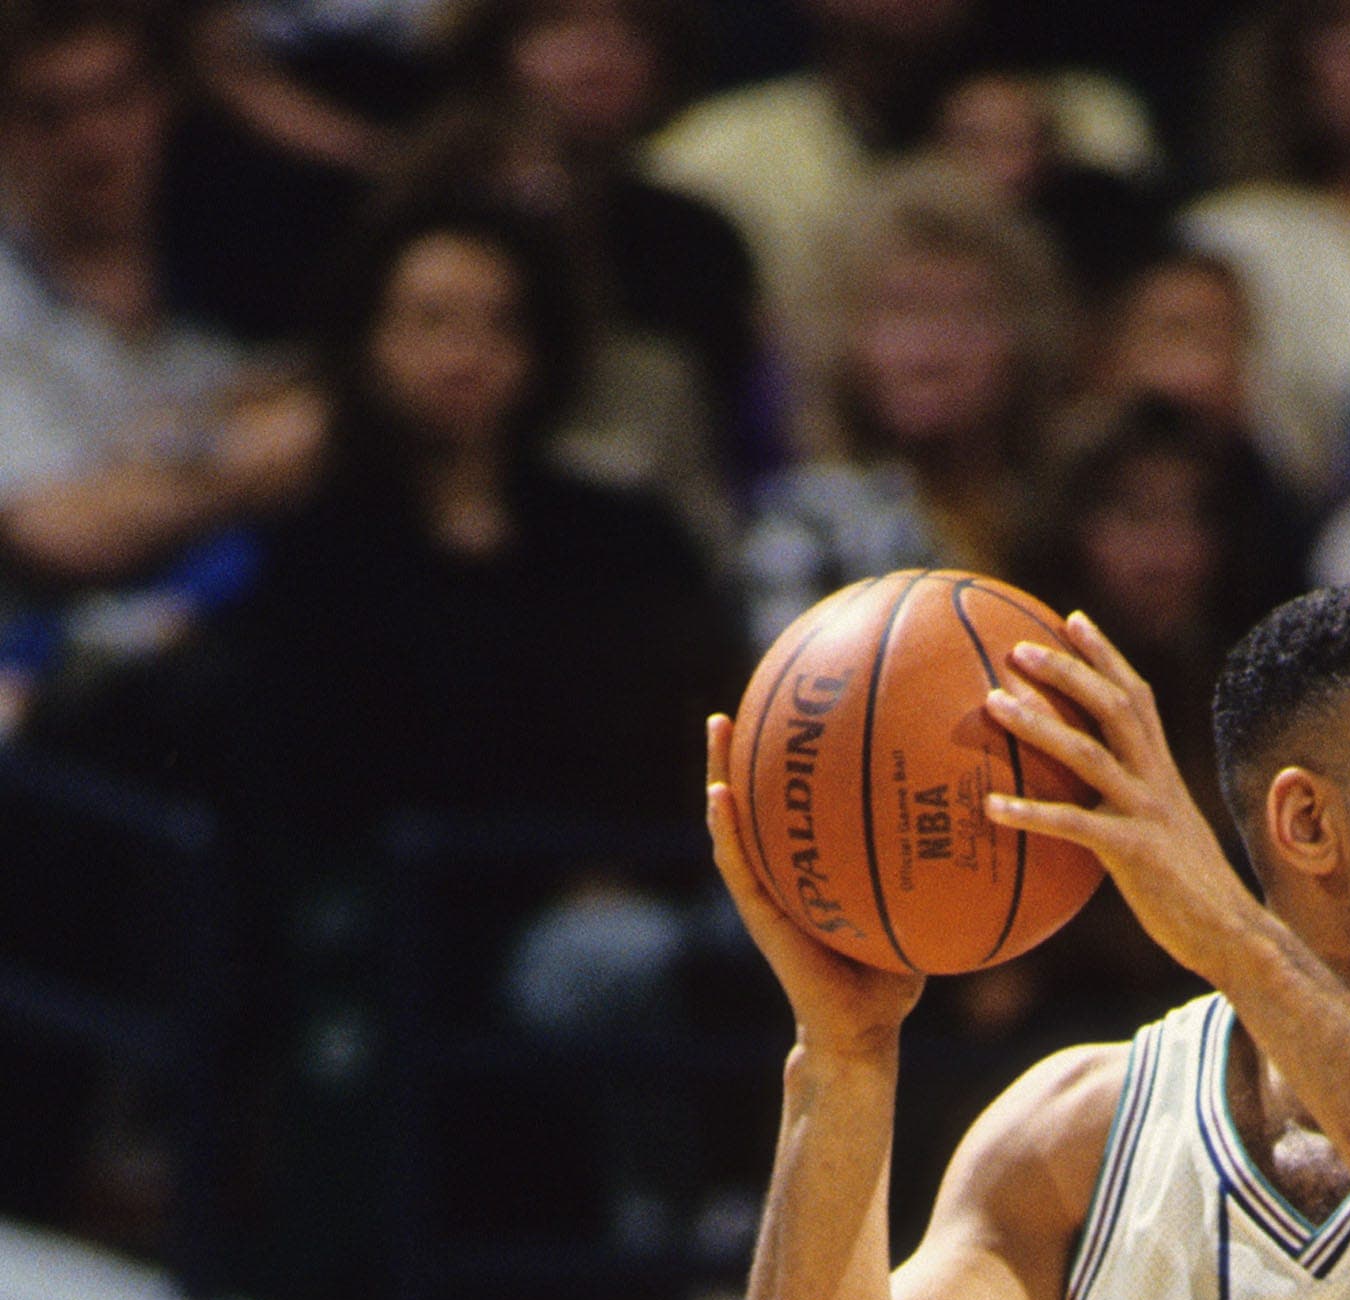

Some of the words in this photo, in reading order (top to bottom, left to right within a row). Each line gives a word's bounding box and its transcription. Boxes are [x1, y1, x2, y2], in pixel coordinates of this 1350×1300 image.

[784, 669, 866, 939] SPALDING
[891, 749, 907, 783] Ball
[913, 783, 953, 861] NBA
